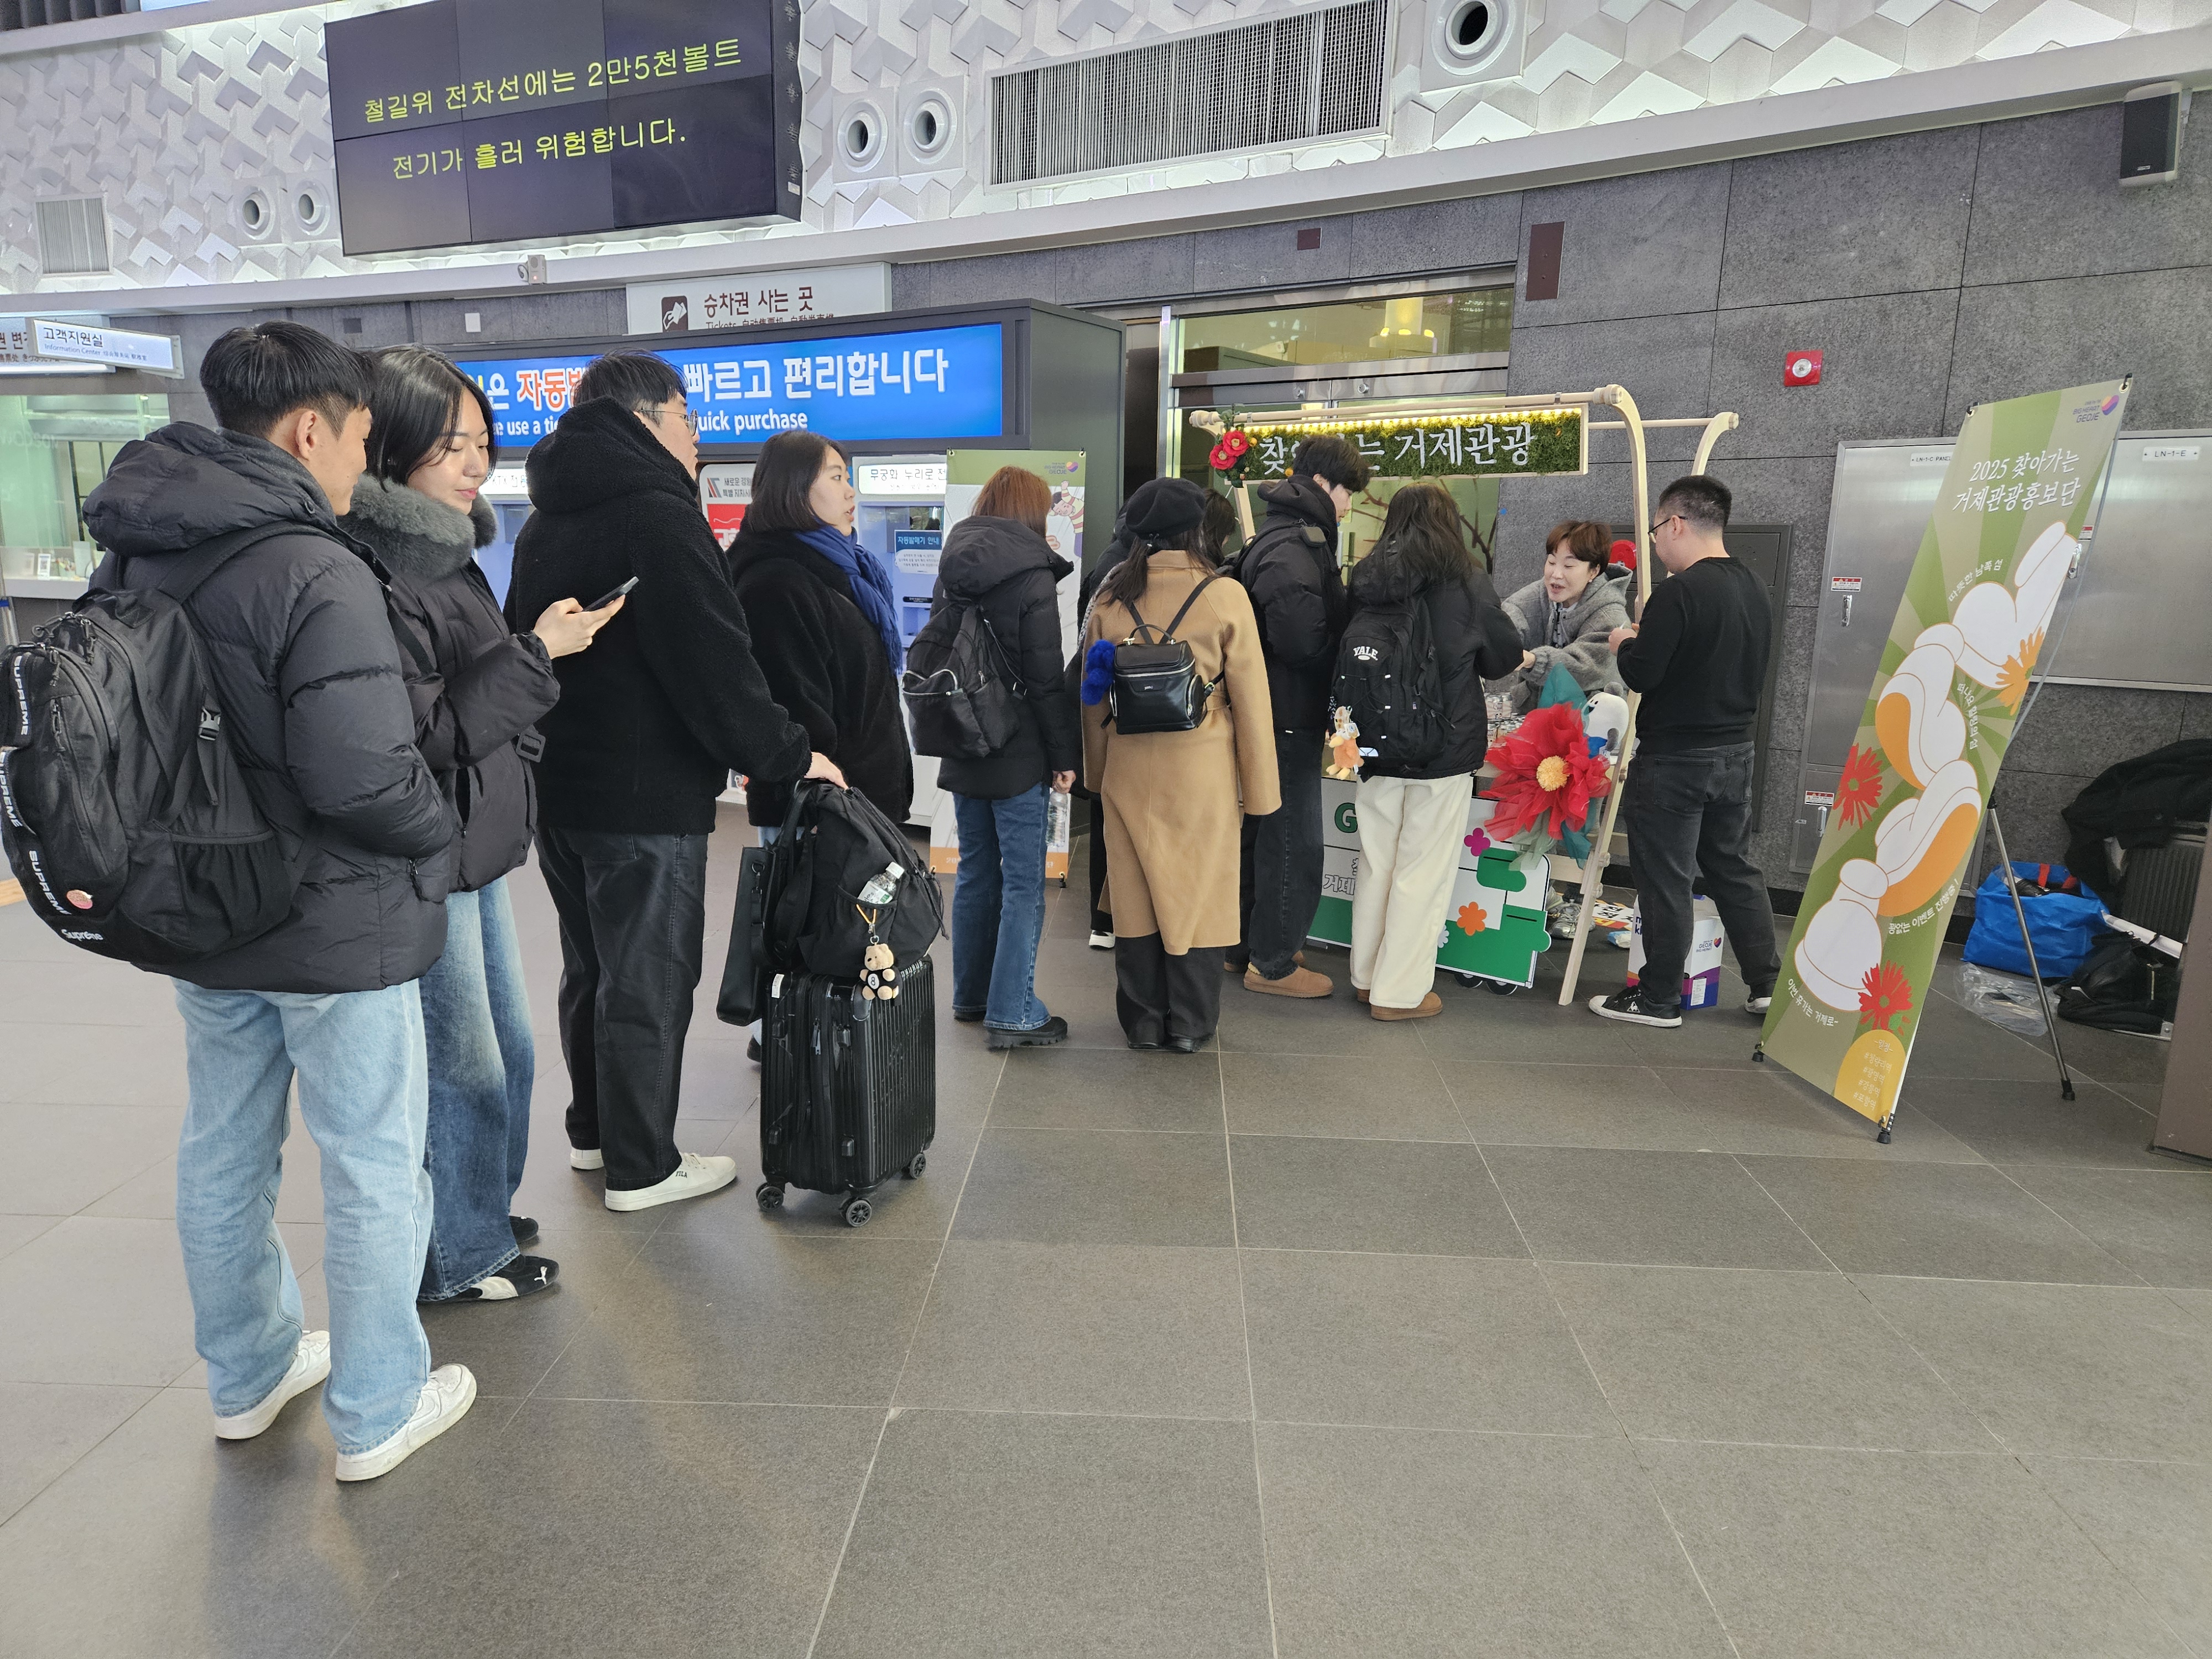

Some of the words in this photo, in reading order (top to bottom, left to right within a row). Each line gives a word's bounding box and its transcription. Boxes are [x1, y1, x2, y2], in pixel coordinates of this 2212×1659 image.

[365, 90, 433, 123] 철길위
[446, 69, 576, 110] 전차선에는
[587, 38, 742, 87] 2만5천볼트
[393, 148, 463, 180] 전기가
[475, 139, 523, 170] 흘러
[536, 118, 686, 160] 위험합니다.
[704, 291, 749, 318] 승차권
[758, 289, 788, 313] 사는
[798, 286, 813, 311] 곳
[11, 332, 27, 349] 변
[43, 327, 104, 348] 고객지원실
[44, 343, 81, 354] Information
[81, 347, 101, 356] Center
[684, 359, 772, 403] 빠르고
[783, 348, 950, 399] 편리합니다
[507, 420, 529, 436] use
[533, 420, 541, 435] a
[696, 410, 731, 431] uick
[734, 408, 808, 436] purchase
[2076, 413, 2100, 423] GEOJE
[1259, 433, 1385, 476] 찾는
[1395, 422, 1536, 469] 거제관광
[870, 469, 898, 481] 무궁화
[905, 468, 933, 481] 누리로
[1969, 457, 2011, 483] 2025
[2011, 448, 2080, 479] 찾아가는
[1952, 477, 2081, 513] 거제관광홍보단
[898, 536, 925, 545] 자동발매기
[927, 536, 940, 545] 안내
[1948, 572, 1973, 602] 따뜻한
[1975, 560, 1992, 577] 남쪽
[1994, 559, 2003, 571] 섬
[1353, 646, 1378, 661] YALE
[14, 655, 28, 735] SUPREME
[1969, 738, 1978, 750] 섬
[1323, 874, 1355, 895] 거제
[1912, 907, 1936, 927] 이벤트
[870, 976, 876, 986] 8
[1788, 978, 1799, 998] 이번
[1795, 994, 1813, 1018] 휴가는
